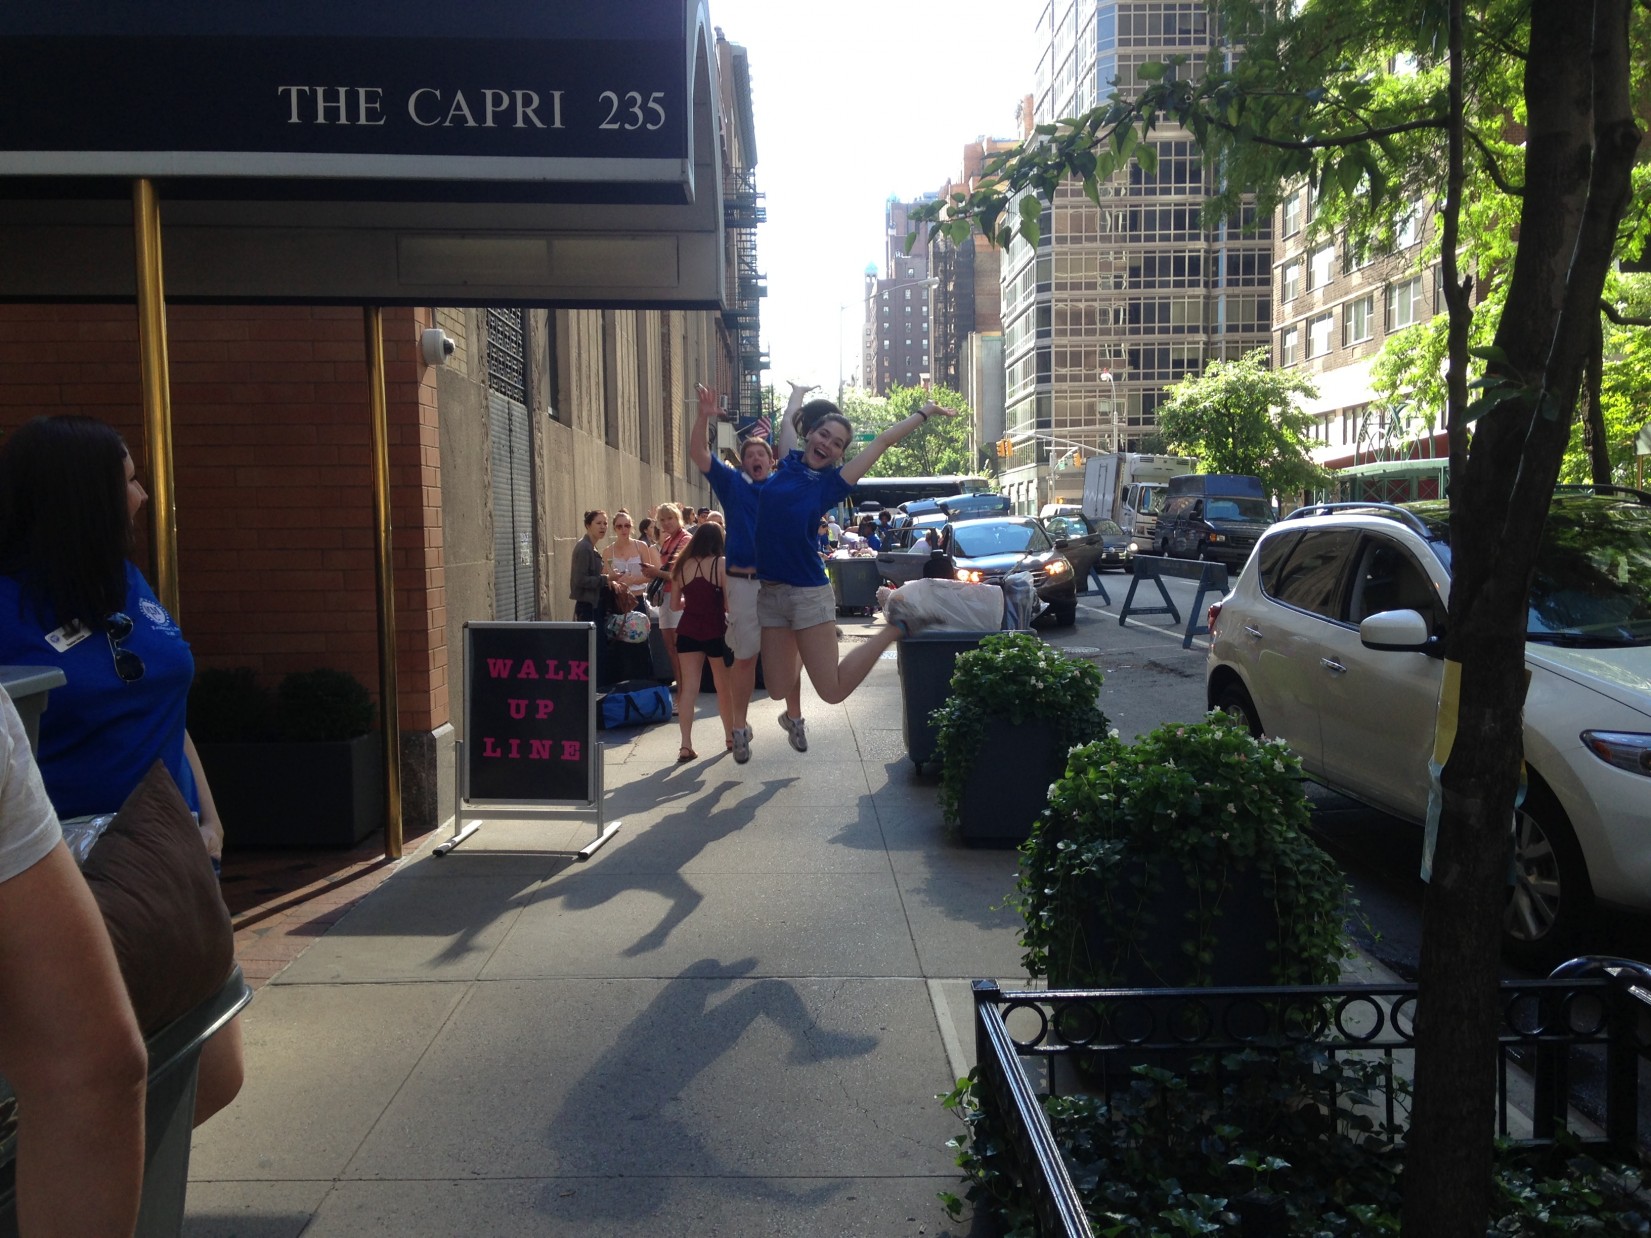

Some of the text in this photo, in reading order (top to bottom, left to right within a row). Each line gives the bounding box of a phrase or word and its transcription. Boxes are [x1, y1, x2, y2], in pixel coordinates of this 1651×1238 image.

[277, 85, 666, 130] THE CAPRI 235
[486, 658, 589, 681] WALK
[508, 699, 555, 719] UP
[482, 737, 583, 761] LINE
